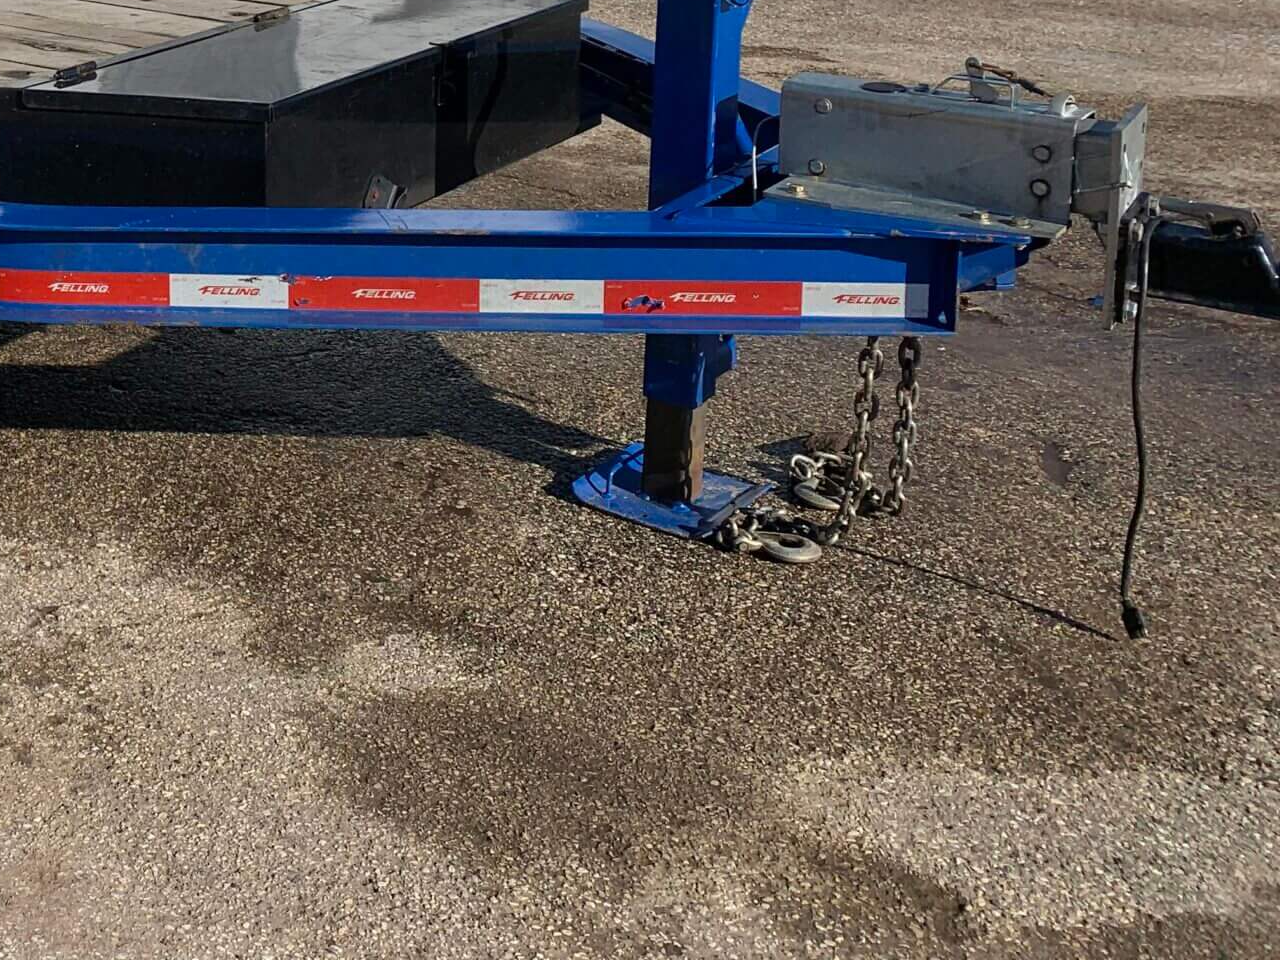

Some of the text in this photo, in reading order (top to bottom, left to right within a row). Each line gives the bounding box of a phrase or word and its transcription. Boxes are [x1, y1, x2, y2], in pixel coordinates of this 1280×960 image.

[47, 282, 109, 294] FELLING
[198, 284, 261, 297] FELLING
[351, 288, 416, 300] FELLING
[508, 290, 575, 302] FELLING
[669, 292, 737, 304] FELLING
[831, 293, 901, 305] FELLING
